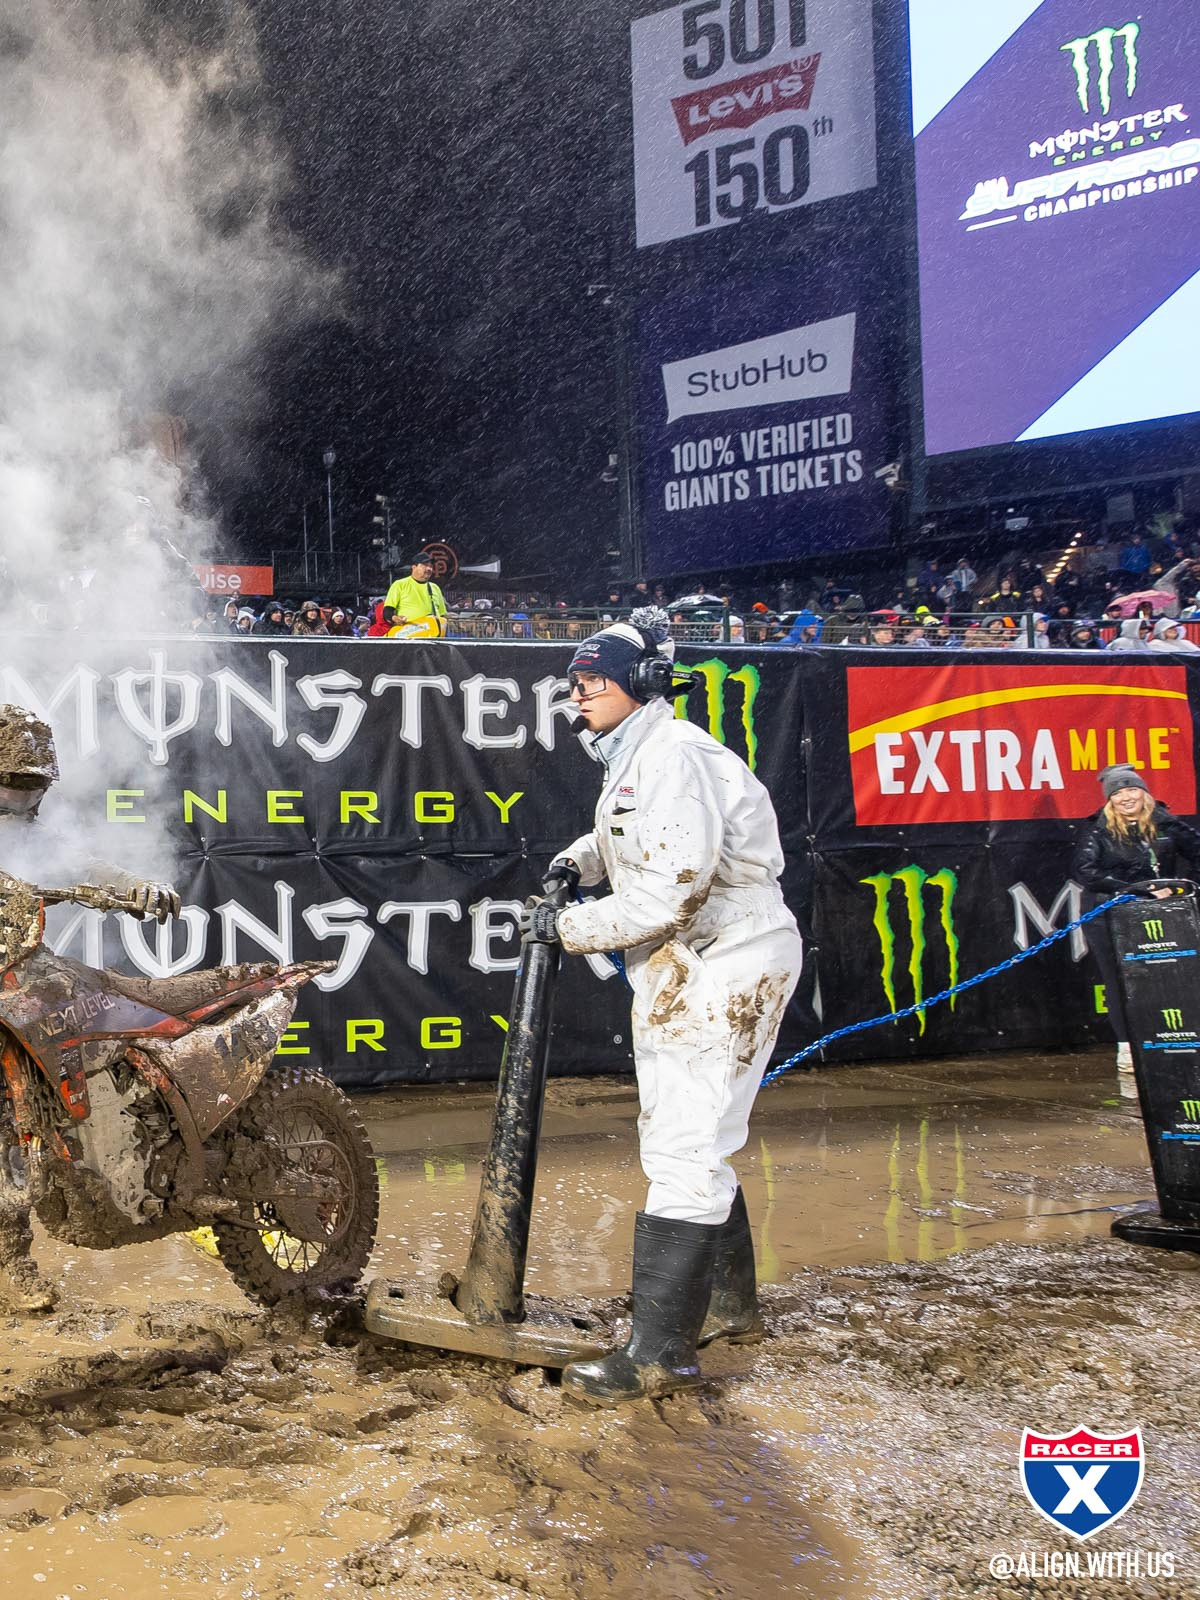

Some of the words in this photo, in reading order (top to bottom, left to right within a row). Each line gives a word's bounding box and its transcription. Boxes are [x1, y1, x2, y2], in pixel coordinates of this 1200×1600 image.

[1029, 103, 1189, 158] MONSTER
[1023, 167, 1198, 222] CHAMPIONSHIP
[687, 349, 828, 397] StubHub
[670, 435, 735, 474] 100%
[740, 413, 853, 462] VERIFIED
[664, 469, 750, 511] GIANTS
[755, 449, 864, 496] TICKETS
[875, 729, 1064, 794] EXTRA
[1069, 728, 1170, 770] MILE
[106, 790, 524, 824] ENERGY
